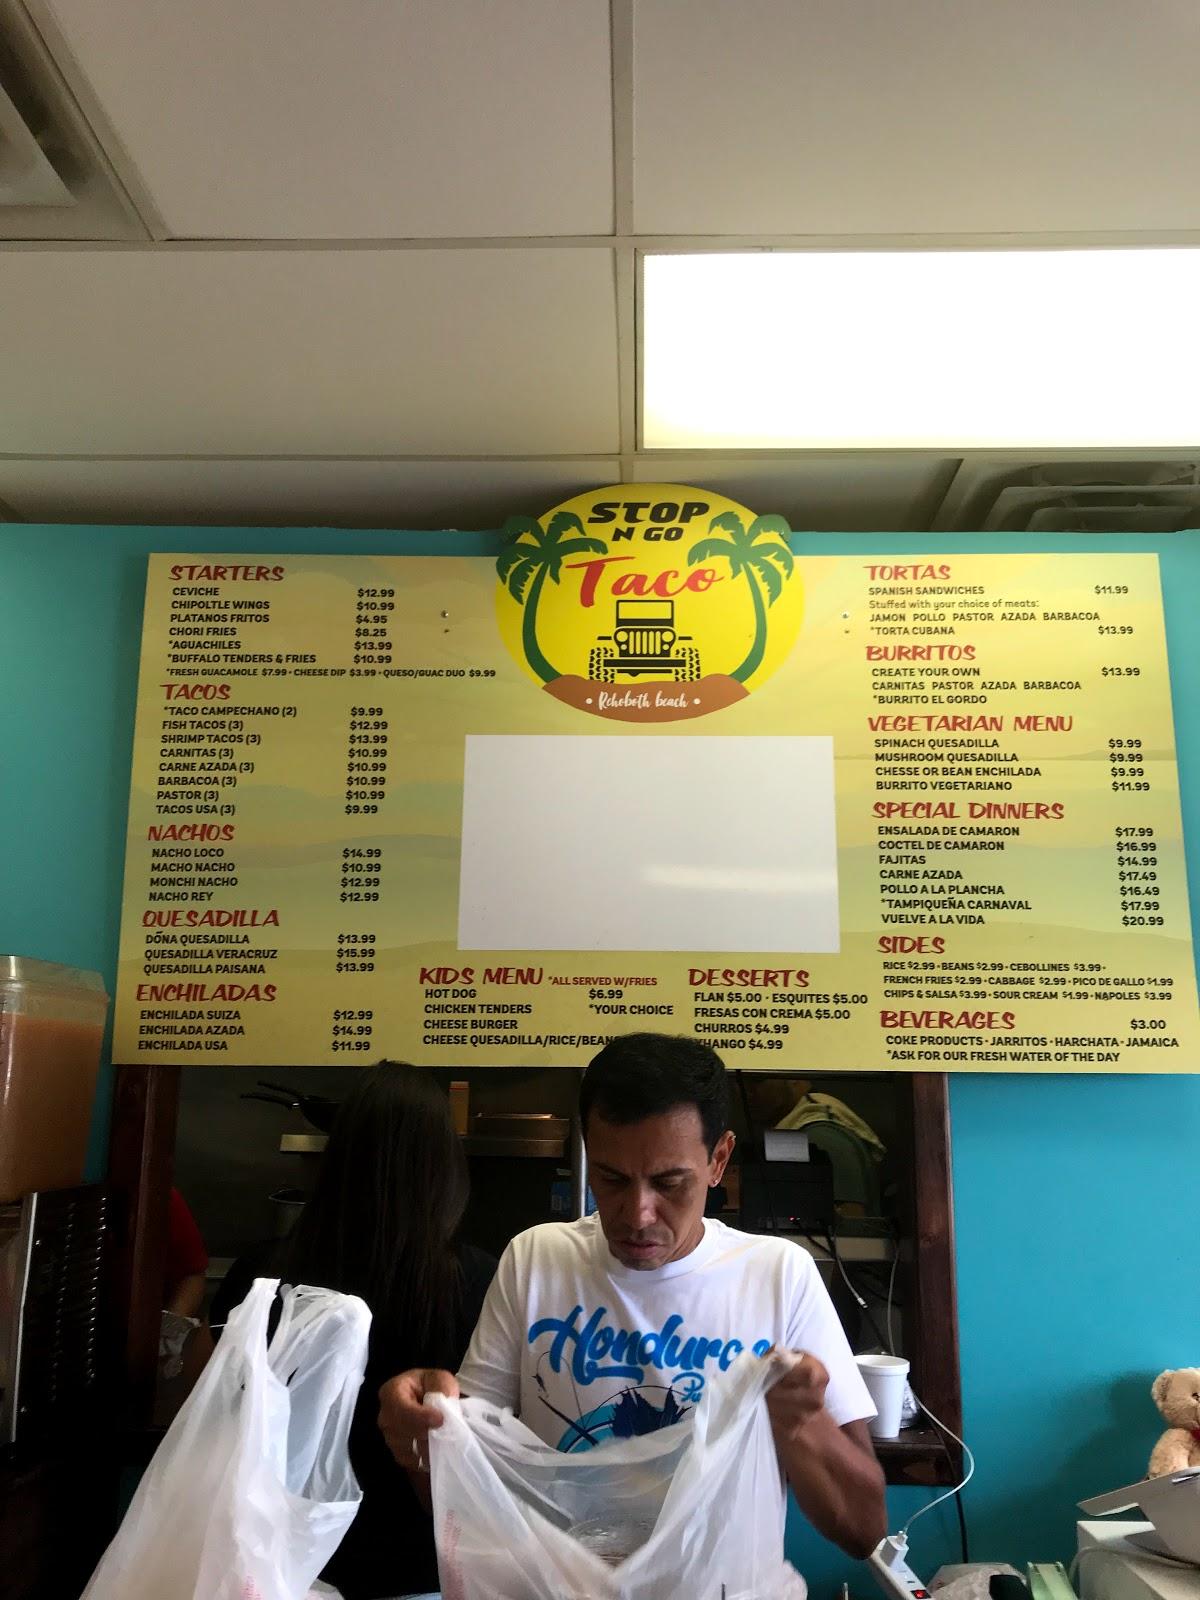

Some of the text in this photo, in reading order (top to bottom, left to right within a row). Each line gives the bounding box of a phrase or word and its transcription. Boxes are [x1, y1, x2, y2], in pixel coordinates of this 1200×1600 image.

[588, 502, 710, 523] STOP
[612, 527, 684, 541] N GO
[168, 565, 284, 581] STARTERS
[864, 565, 950, 580] TORTAS
[565, 556, 725, 608] Taco
[172, 586, 394, 598] CEVICHE $12.99
[869, 584, 1128, 596] SPANISH SANDWICHES $11.99
[172, 599, 394, 611] CHIPOLTLE WINGS $10.99
[869, 599, 906, 609] Stuffed
[908, 599, 931, 609] with
[934, 601, 956, 611] your
[958, 599, 989, 609] choice
[992, 598, 1002, 608] of
[170, 613, 387, 624] PLATANOS FRITOS $4.95
[870, 611, 1100, 623] JAMON POLLO PASTOR AZADA BARBACOA
[169, 626, 387, 637] CHORI FRIES $8.25
[866, 645, 976, 661] BURRITOS
[201, 667, 258, 677] GUACAMOLE
[262, 667, 287, 677] $7.99
[294, 668, 328, 677] CHEESE
[330, 668, 346, 677] DIP
[350, 667, 376, 677] $3.99
[383, 669, 444, 678] QUESO/GUAC
[446, 669, 465, 678] DUO
[469, 668, 496, 678] $9.99
[872, 666, 1140, 677] CREATE YOUR OWN $13.99
[160, 684, 231, 700] TACOS
[655, 690, 688, 708] beach
[932, 695, 944, 705] EL
[946, 694, 987, 704] GORDO
[201, 706, 280, 716] CAMPECHANO
[282, 706, 296, 717] (2)
[351, 706, 383, 717] $9.99
[162, 719, 388, 731] FISH TACOS (3) $12.99
[868, 716, 1072, 732] VEGETARIAN MENU
[875, 752, 1143, 763] MUSHROOM QUESADILLA $9.99
[159, 761, 386, 773] CARNE AZADA (3) $10.99
[876, 766, 1144, 777] CHESSE OR BEAN ENCHILADA $9.99
[158, 775, 386, 787] BARBACOA (3) $10.99
[872, 802, 1064, 819] SPECIAL DINNERS
[148, 824, 235, 842] NACHOS
[879, 854, 1157, 866] FAJITAS $14.99
[151, 862, 381, 873] MACHO NACHO $10.99
[150, 876, 380, 887] MONCHI NACHO $12.99
[880, 883, 1159, 896] POLLO A LA PLANCHA $16.49
[142, 910, 279, 927] QUESADILLA
[878, 936, 945, 954] SIDES
[144, 947, 375, 960] QUESADILLA VERACRUZ $15.99
[144, 962, 374, 975] QUESADILLA PAISANA $13.99
[883, 961, 906, 971] RICE
[908, 961, 935, 971] $2.99
[941, 961, 974, 971] BEANS
[976, 961, 1004, 971] $2.99
[1074, 962, 1101, 972] $3.99
[420, 968, 474, 984] KIDS
[483, 967, 543, 985] MENU
[572, 976, 612, 986] SERVED
[614, 976, 657, 987] W/FRIES
[688, 969, 809, 987] DESSERTS
[136, 984, 277, 1002] ENCHILADAS
[425, 988, 623, 1000] HOT DOG $6.99
[694, 991, 868, 1005] FLAN $5.00 ESQUITES $5.00
[884, 989, 914, 999] CHIPS
[916, 989, 924, 999] &
[925, 989, 958, 999] SALSA
[959, 989, 987, 999] $3.99
[993, 990, 1021, 1000] SOUR
[1022, 991, 1058, 1000] CREAM
[1062, 990, 1088, 1000] $1.99
[1144, 991, 1172, 1001] $3.99
[140, 1009, 373, 1020] ENCHILADA SUIZA $12.99
[425, 1003, 476, 1014] CHICKEN
[478, 1003, 532, 1014] TENDERS
[630, 1004, 673, 1015] CHOICE
[424, 1019, 518, 1029] CHEESE BURGER
[880, 1010, 1166, 1030] BEVERAGES $3.00
[694, 1022, 789, 1034] CHURROS $4.99
[138, 1039, 370, 1051] ENCHILADA USA $11.99
[886, 1035, 1179, 1047] COKE PRODUCTS JARRITOS HARCHATA JAMAICA
